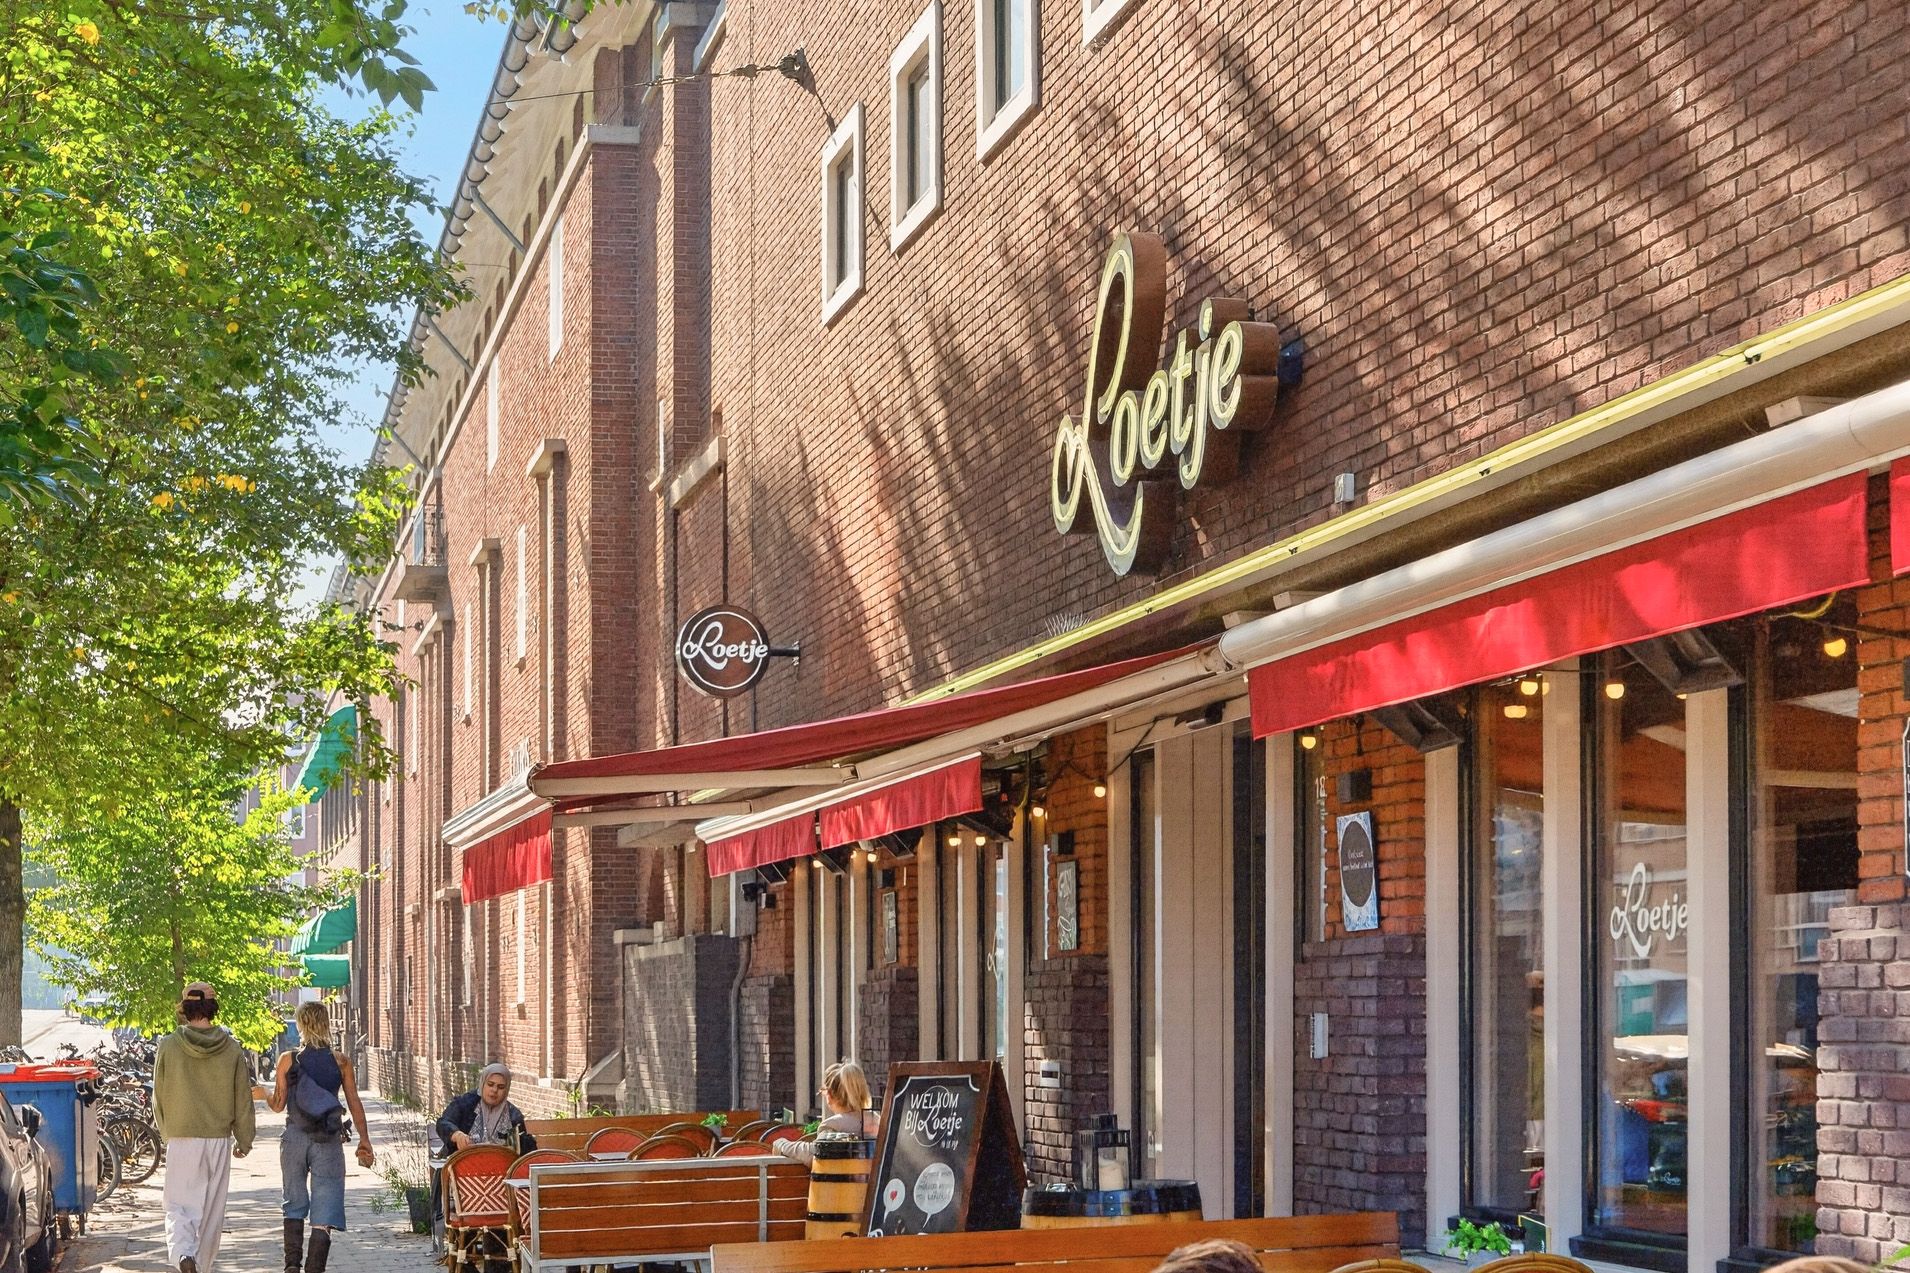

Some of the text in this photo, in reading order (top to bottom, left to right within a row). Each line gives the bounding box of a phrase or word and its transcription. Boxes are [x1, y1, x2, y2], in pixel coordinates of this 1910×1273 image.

[1052, 231, 1244, 577] Loetje
[682, 620, 769, 671] Loetje
[1610, 862, 1688, 958] Loetje
[904, 1104, 963, 1141] BIJ Loetje
[910, 1092, 960, 1110] WELKOM
